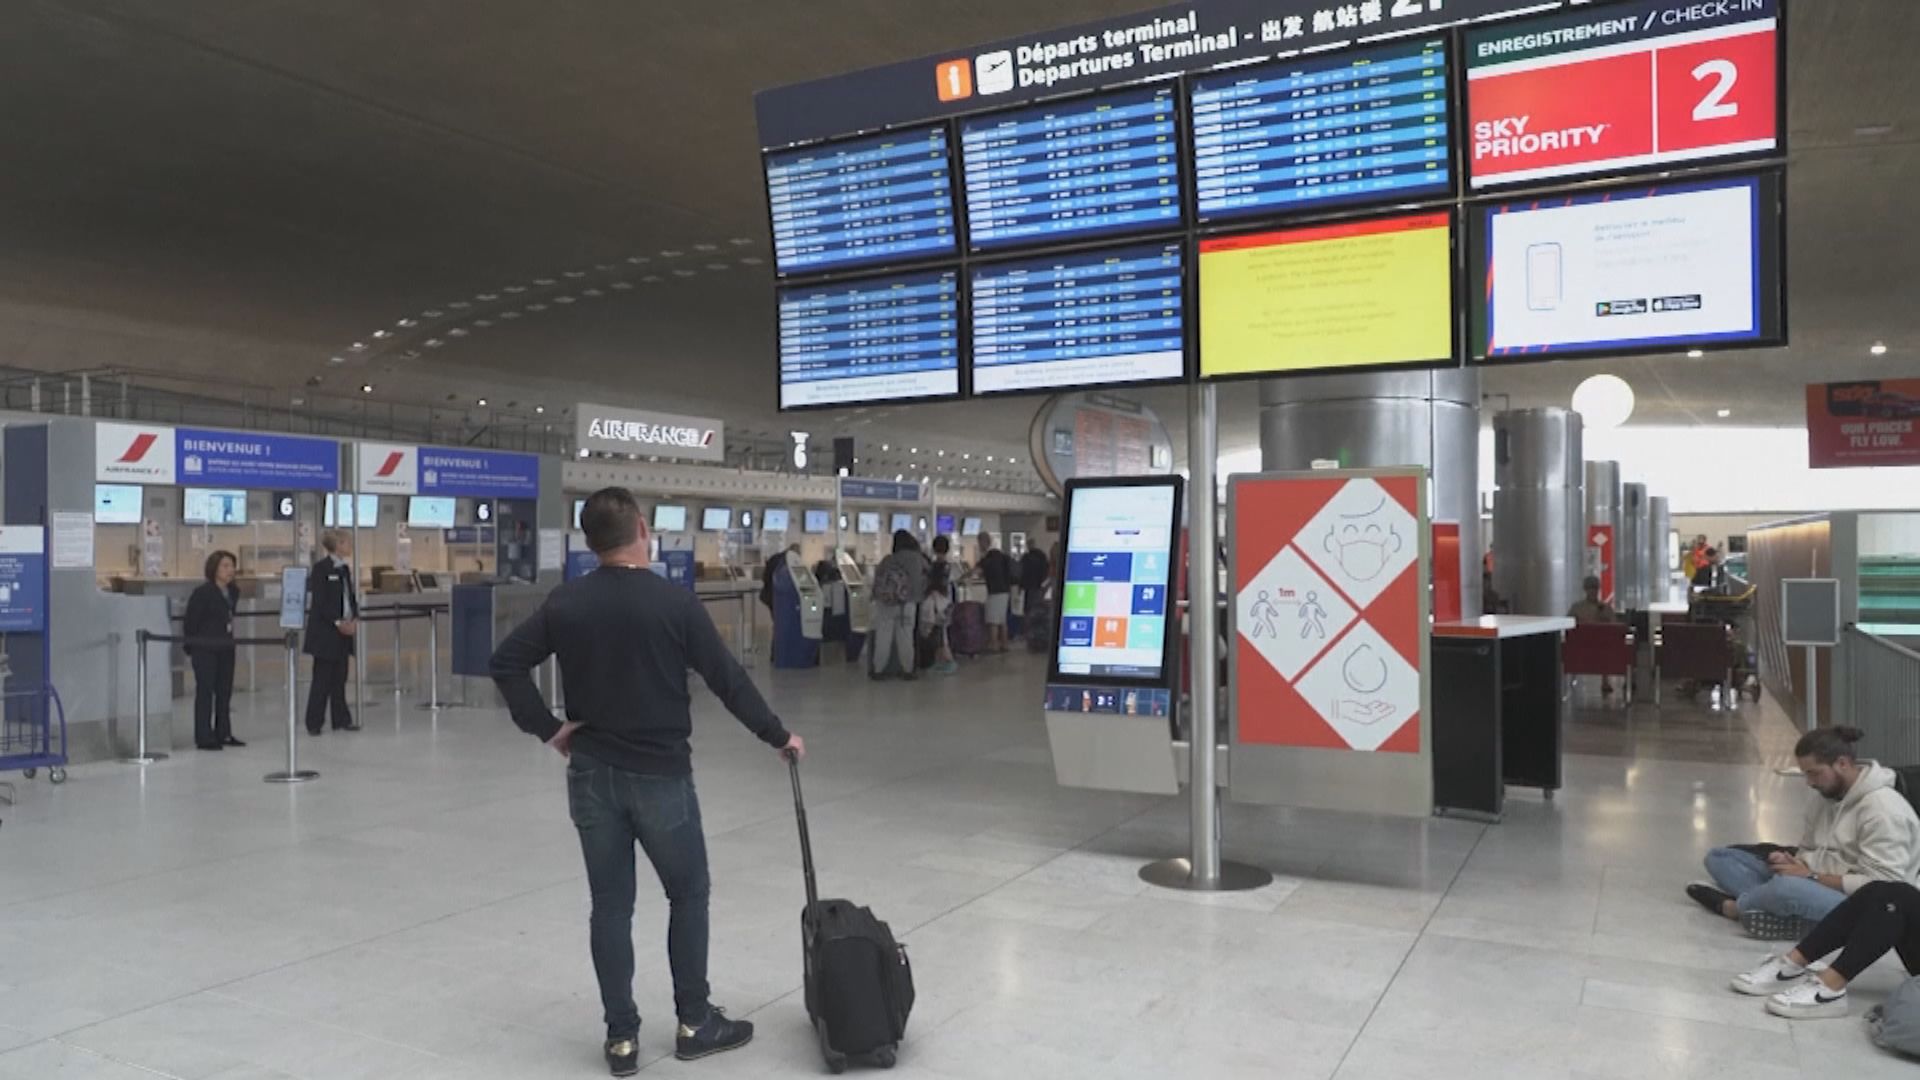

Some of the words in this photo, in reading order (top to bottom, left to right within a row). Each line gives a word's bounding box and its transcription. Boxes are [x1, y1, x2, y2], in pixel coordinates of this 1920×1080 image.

[1016, 34, 1098, 66] Départs
[1103, 10, 1197, 48] terminal
[1477, 16, 1638, 58] ENREGISTREMENT
[1661, 0, 1763, 26] CHECK-IN
[1018, 50, 1135, 87] Departures
[1139, 26, 1237, 63] Terminal
[1691, 59, 1739, 121] 2
[1475, 115, 1529, 139] SKY
[1475, 124, 1606, 159] PRIORITY
[1841, 423, 1865, 434] OUR
[1868, 421, 1912, 433] PRICES
[183, 439, 262, 455] BIENVENUE
[1850, 435, 1869, 447] FLY
[423, 456, 482, 470] BIENVENUE
[794, 442, 807, 469] 6
[279, 497, 294, 516] 6
[477, 503, 490, 520] 6
[1278, 587, 1295, 597] 1m
